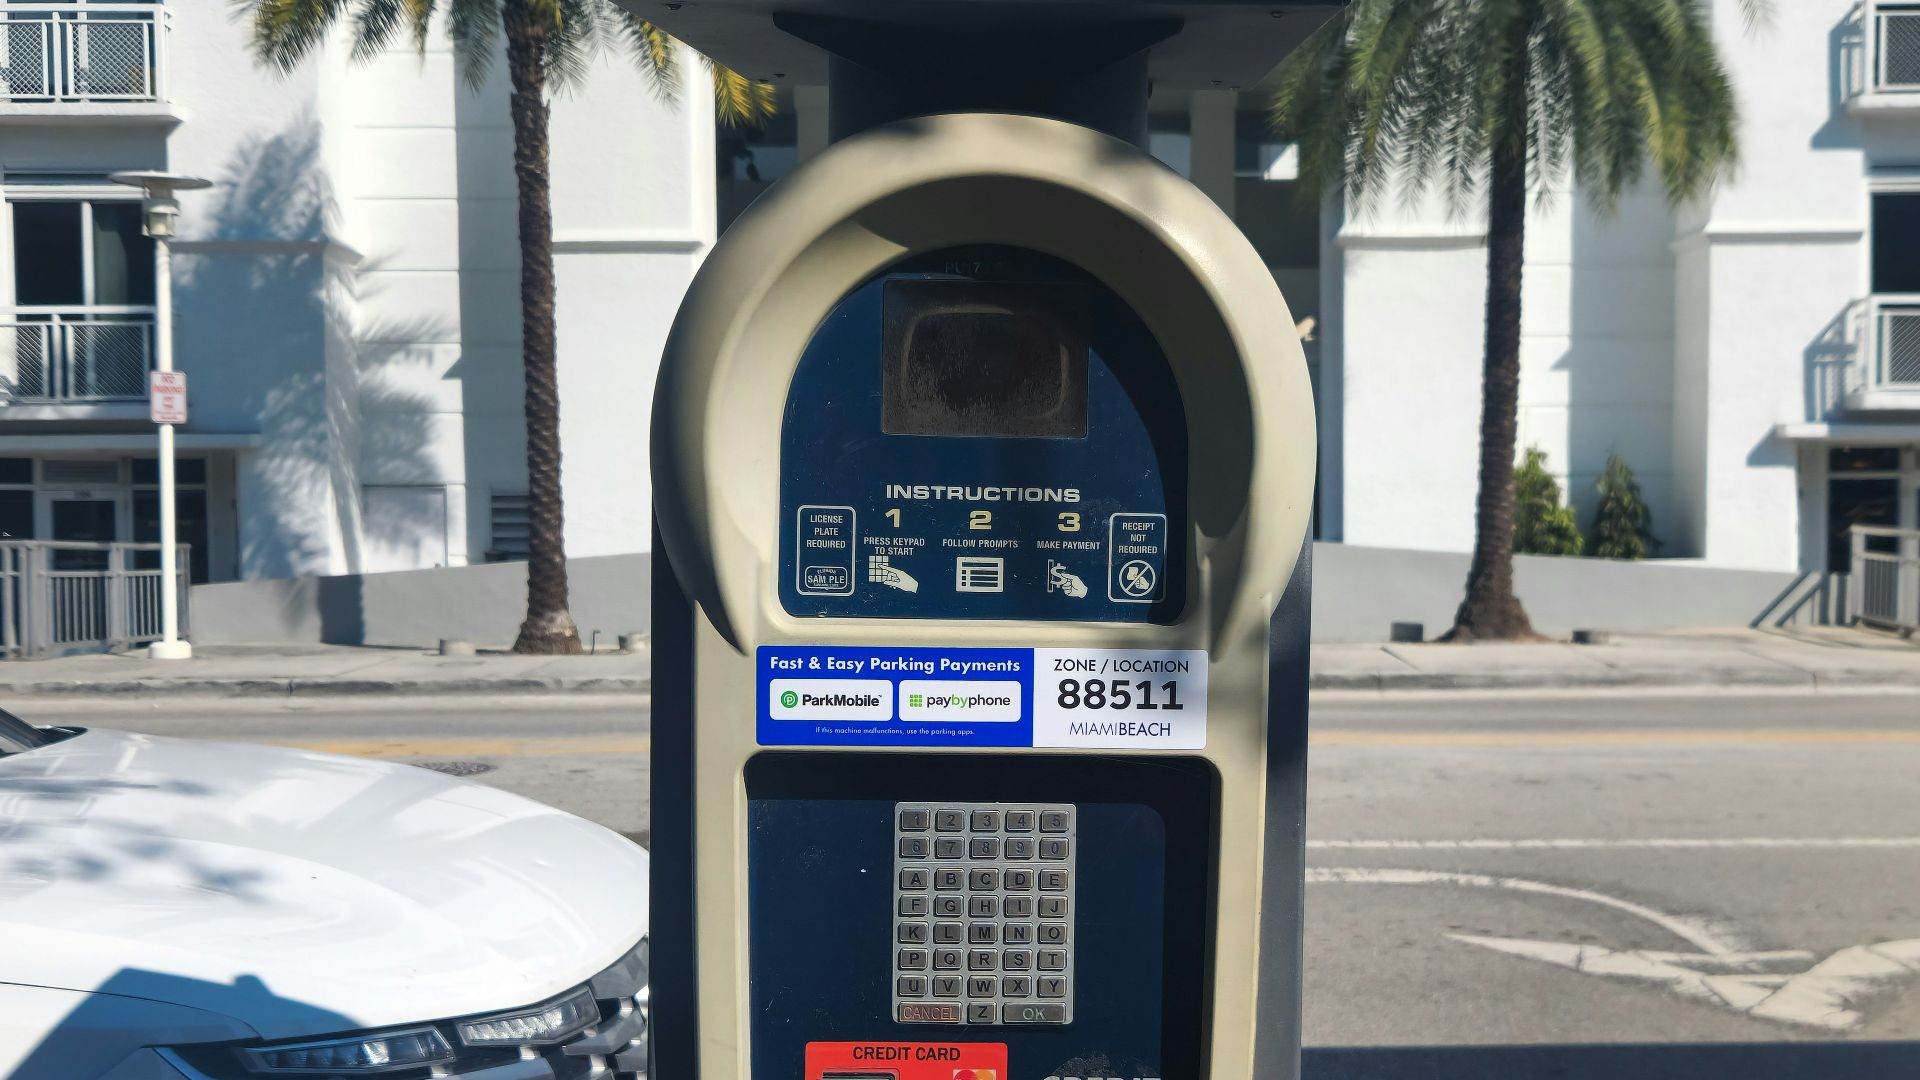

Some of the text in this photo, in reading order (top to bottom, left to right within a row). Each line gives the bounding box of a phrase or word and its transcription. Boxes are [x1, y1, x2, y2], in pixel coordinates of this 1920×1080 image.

[886, 485, 1080, 502] INSTRUCTIONS
[810, 514, 844, 524] LICENSE
[884, 508, 900, 528] 1
[970, 510, 992, 530] 2
[1058, 512, 1080, 532] 3
[814, 528, 838, 536] PLATE
[1122, 522, 1156, 530] RECEIPT
[806, 540, 846, 548] REQUIRED
[864, 536, 925, 546] PRESS KEYPAD
[942, 538, 1018, 548] FOLLOW PROMPTS
[1130, 534, 1146, 542] NOT
[874, 547, 914, 556] TO START
[1036, 541, 1100, 550] MAKE PAYMENT
[1118, 546, 1158, 554] REQUIRED
[808, 576, 826, 584] SAM
[770, 656, 1020, 674] Fast & Easy Parking Payments
[1054, 659, 1189, 674] ZONE / LOCATION
[1058, 678, 1184, 710] 88511
[926, 694, 1010, 708] paybyphone
[863, 727, 904, 735] malfunctions,
[931, 728, 956, 736] parking
[915, 814, 1061, 826] 1 2 3 4 5
[913, 841, 1059, 854] 6 7 8 9 0
[911, 873, 1059, 886] A B C D E
[912, 899, 1058, 912] F G H I J
[909, 927, 1060, 939] K L M N O
[910, 953, 1057, 966] P Q R S T
[909, 980, 1059, 992] U V W X Y
[903, 1007, 1046, 1020] CANCEL Z OK
[852, 1046, 960, 1061] CREDIT CARD
